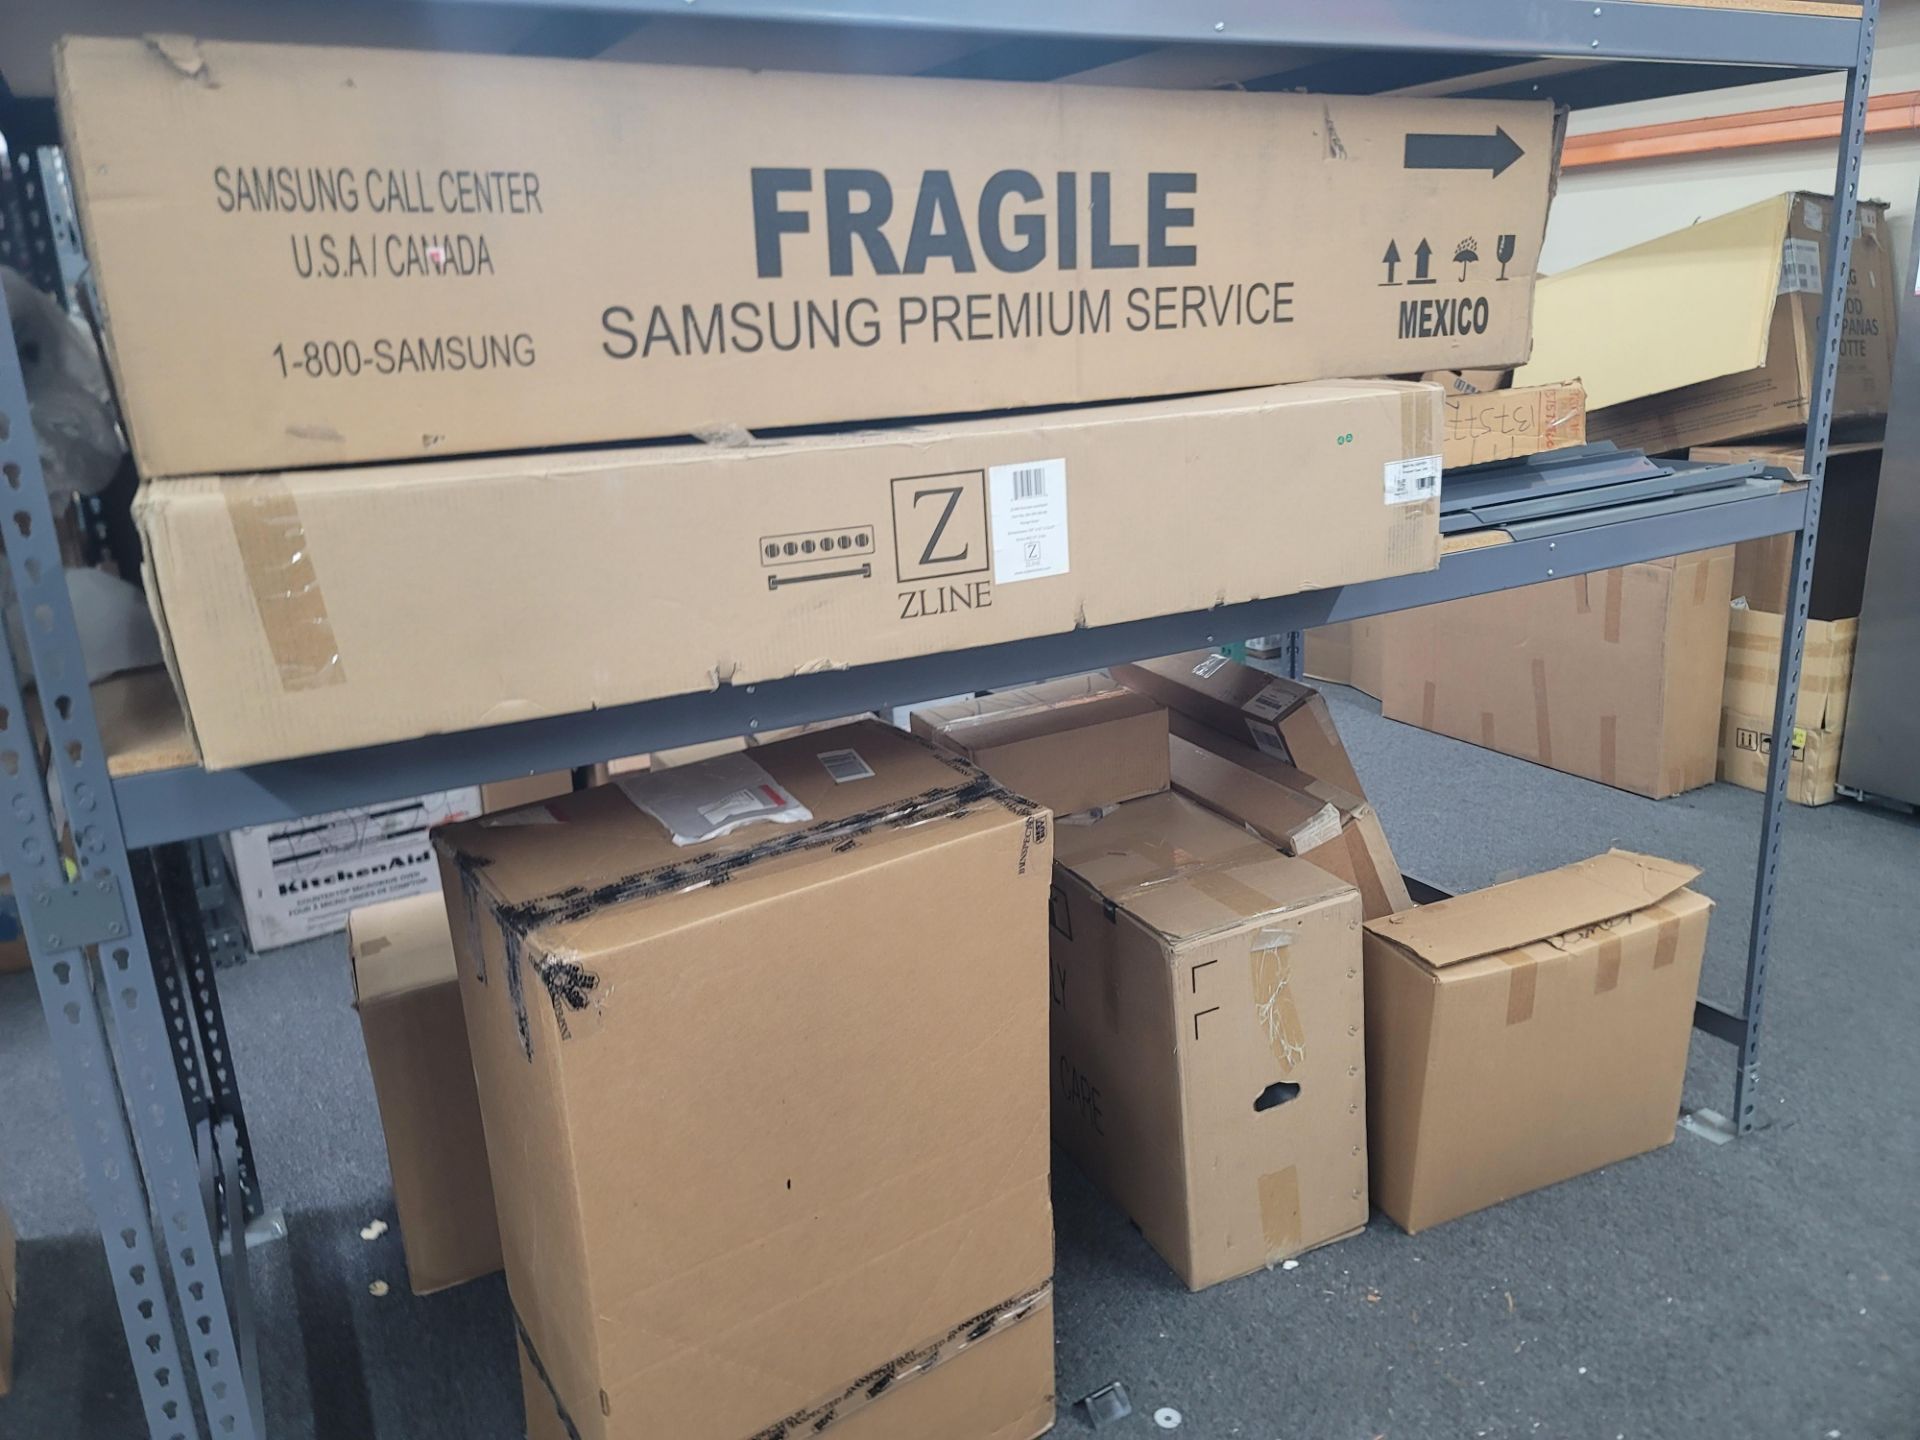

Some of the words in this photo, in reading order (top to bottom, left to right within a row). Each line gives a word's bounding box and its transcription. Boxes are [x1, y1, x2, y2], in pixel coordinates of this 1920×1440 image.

[214, 166, 358, 213] SAMSUNG
[365, 168, 433, 213] CALL
[439, 170, 542, 214] CENTER
[750, 166, 1198, 279] FRAGILE
[386, 234, 494, 277] CANADA
[602, 297, 881, 360] SAMSUNG
[898, 288, 1111, 344] PREMIUM
[1126, 281, 1295, 332] SERVICE
[1397, 296, 1490, 340] MEXICO
[272, 333, 536, 378] 1-800-SAMSUNG
[914, 486, 968, 565] Z
[898, 580, 992, 620] ZLINE
[279, 850, 431, 896] KitchenAid
